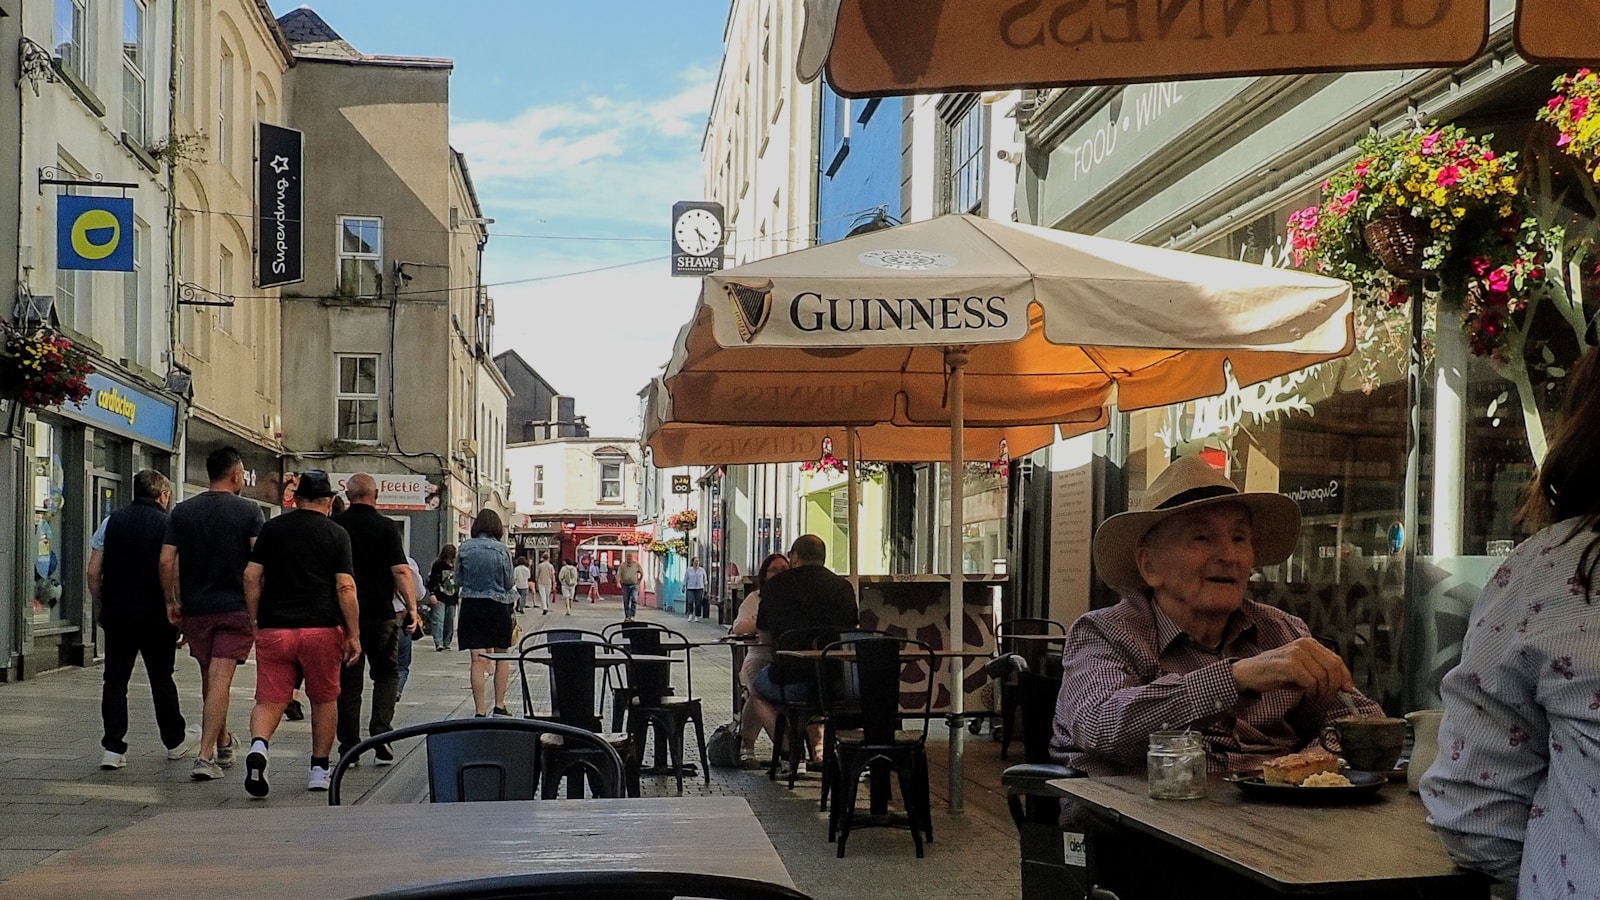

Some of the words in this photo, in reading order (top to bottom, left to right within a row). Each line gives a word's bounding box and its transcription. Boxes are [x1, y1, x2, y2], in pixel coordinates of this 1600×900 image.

[1074, 121, 1118, 182] FOOD
[271, 177, 290, 275] Superdrug
[677, 256, 719, 269] SHAWS
[789, 291, 1009, 332] GUINNESS
[380, 479, 420, 493] Feetie
